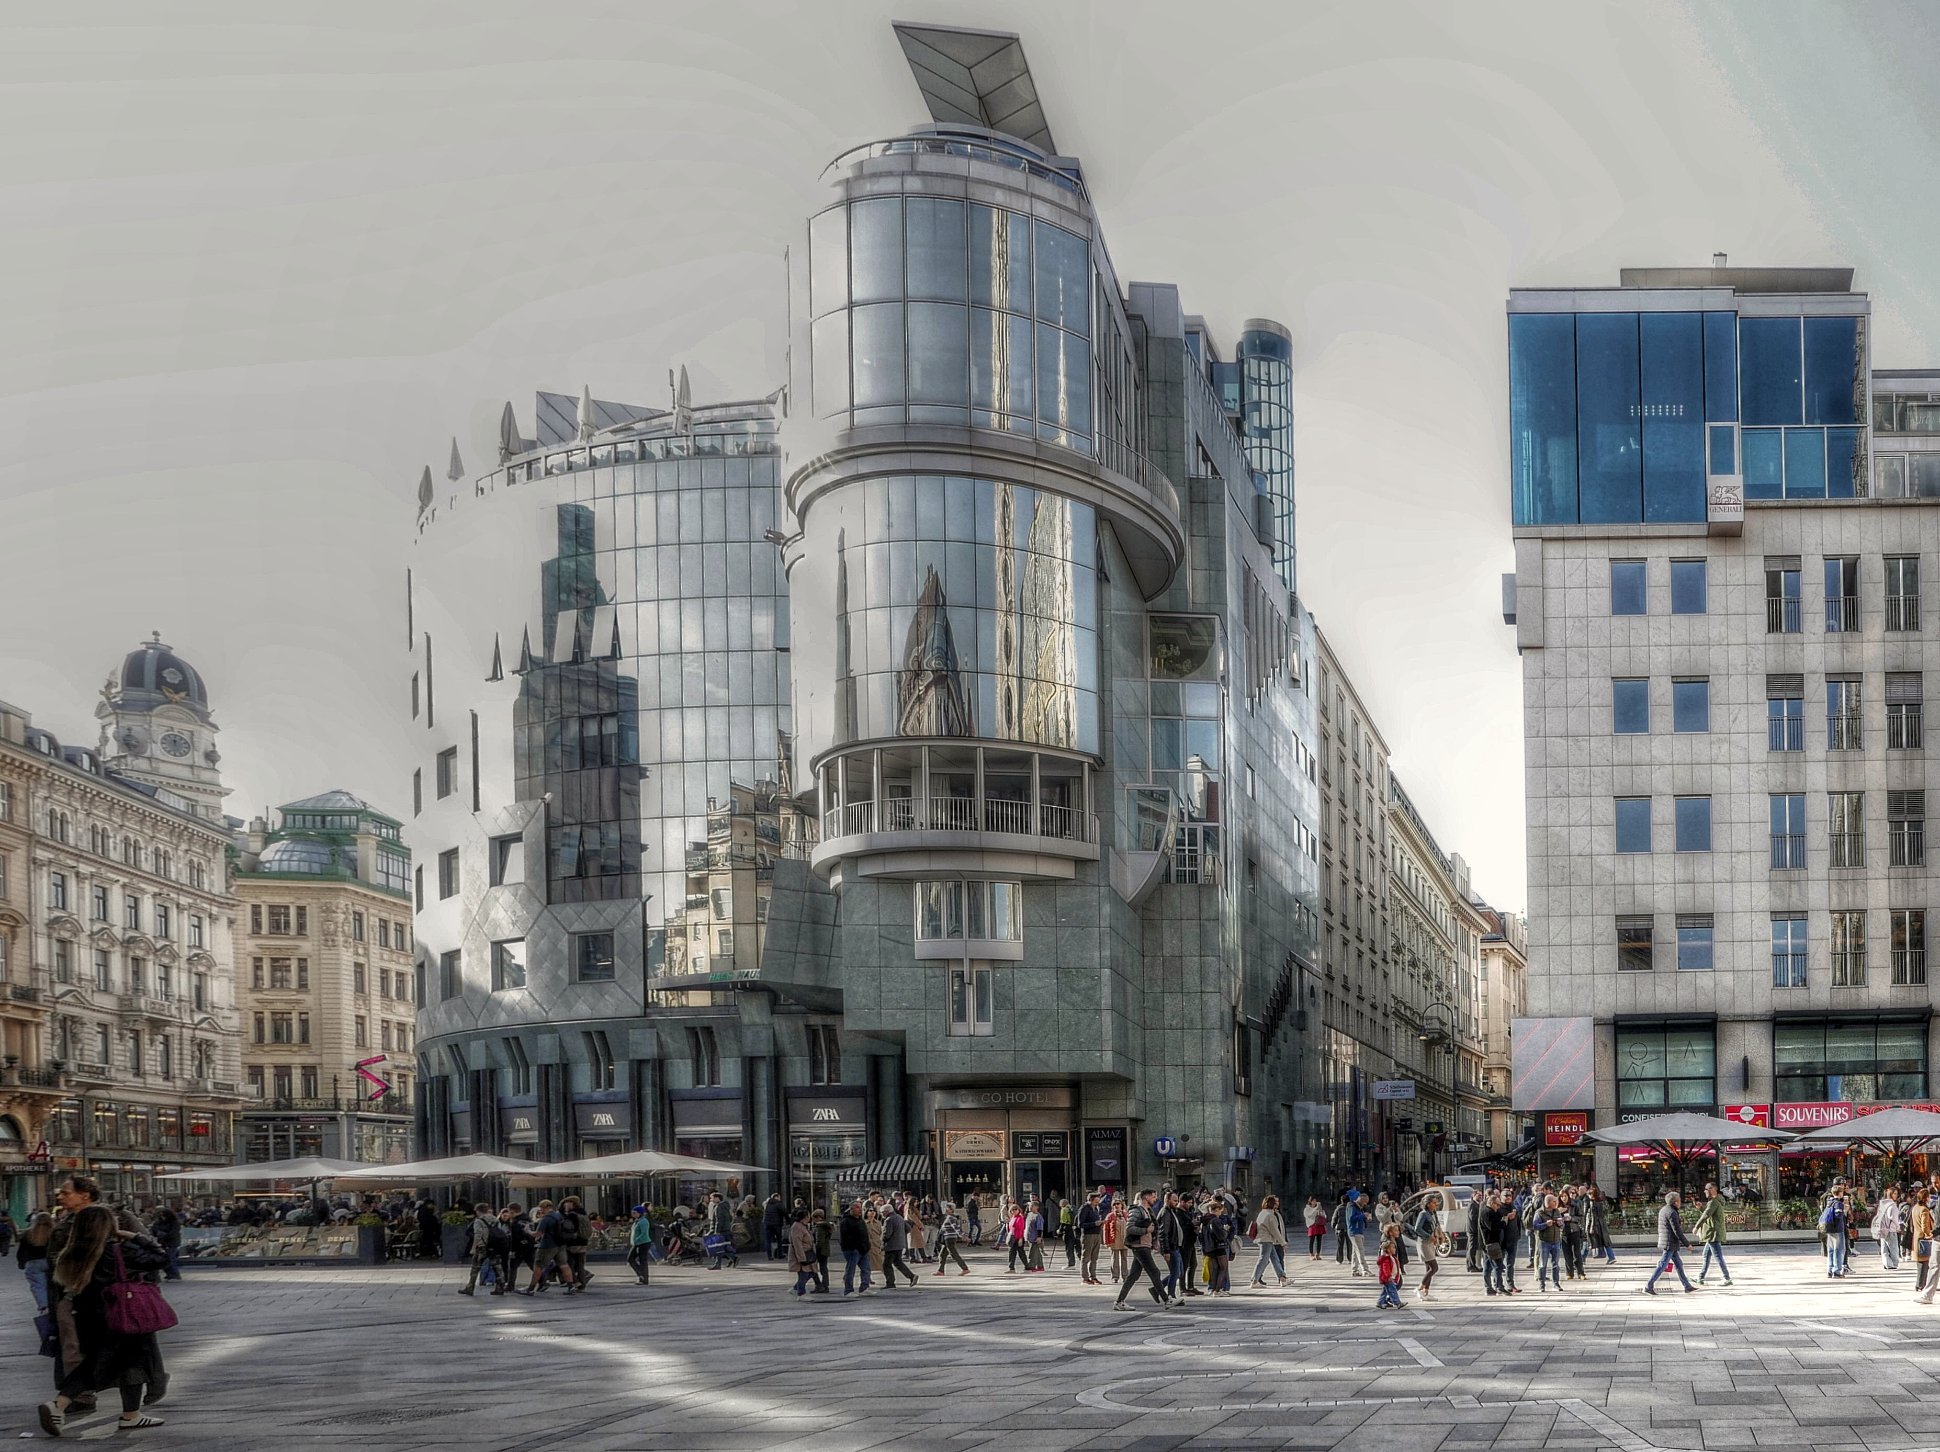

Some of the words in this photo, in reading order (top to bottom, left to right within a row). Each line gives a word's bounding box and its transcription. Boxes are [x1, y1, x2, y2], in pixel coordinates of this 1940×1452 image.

[981, 1092, 1002, 1103] CO
[1005, 1091, 1049, 1103] HOTEL
[593, 1113, 615, 1126] ZARA
[812, 1108, 840, 1120] ZARA
[1779, 1107, 1849, 1121] SOUVENIRS
[514, 1118, 531, 1129] ZARA
[1091, 1130, 1121, 1139] ALMAZ
[1156, 1141, 1170, 1154] U
